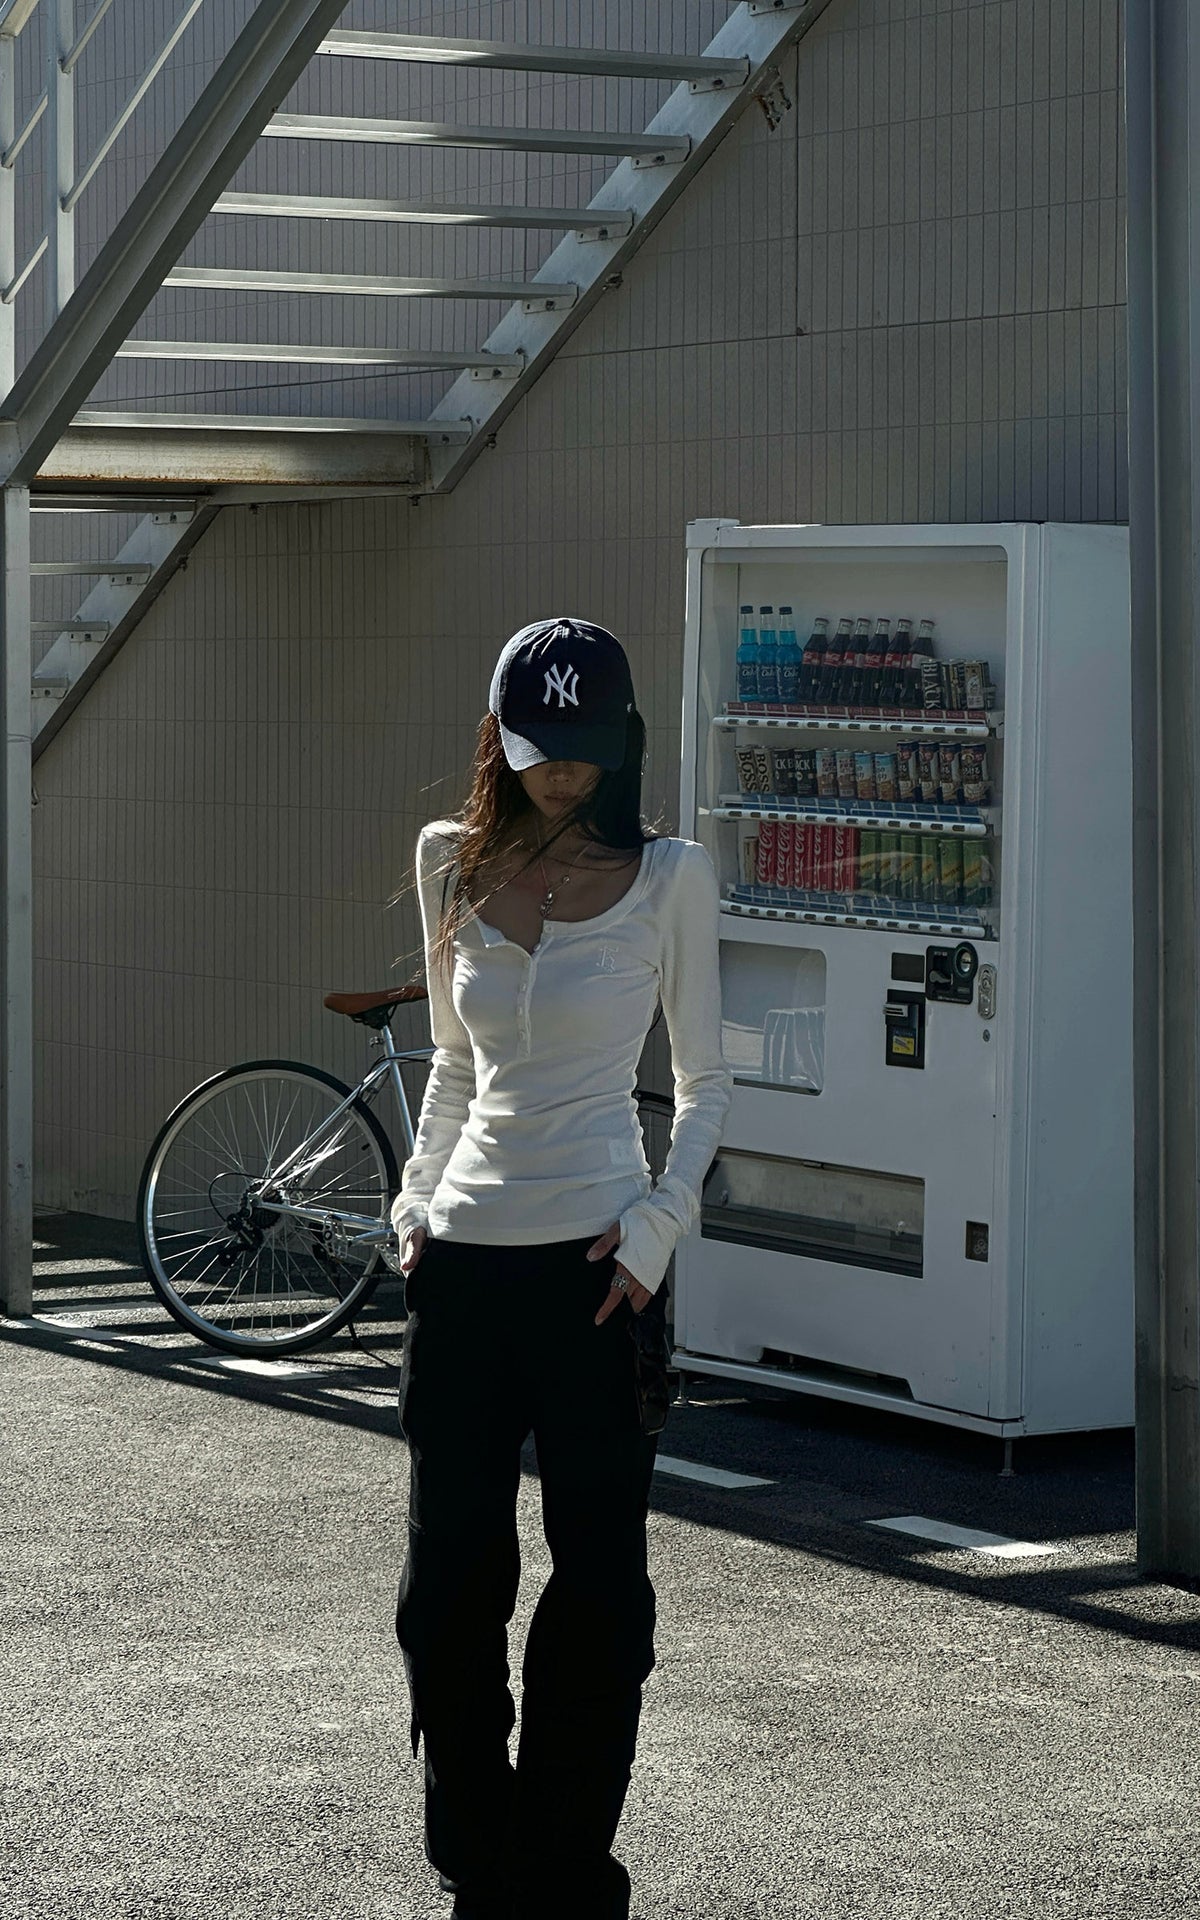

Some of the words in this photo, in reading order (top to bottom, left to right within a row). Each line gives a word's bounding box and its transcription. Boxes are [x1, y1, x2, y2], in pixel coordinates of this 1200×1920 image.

[542, 663, 580, 708] NY
[922, 662, 941, 710] BLACK
[738, 751, 758, 794] BOSS
[756, 753, 770, 793] BOSS
